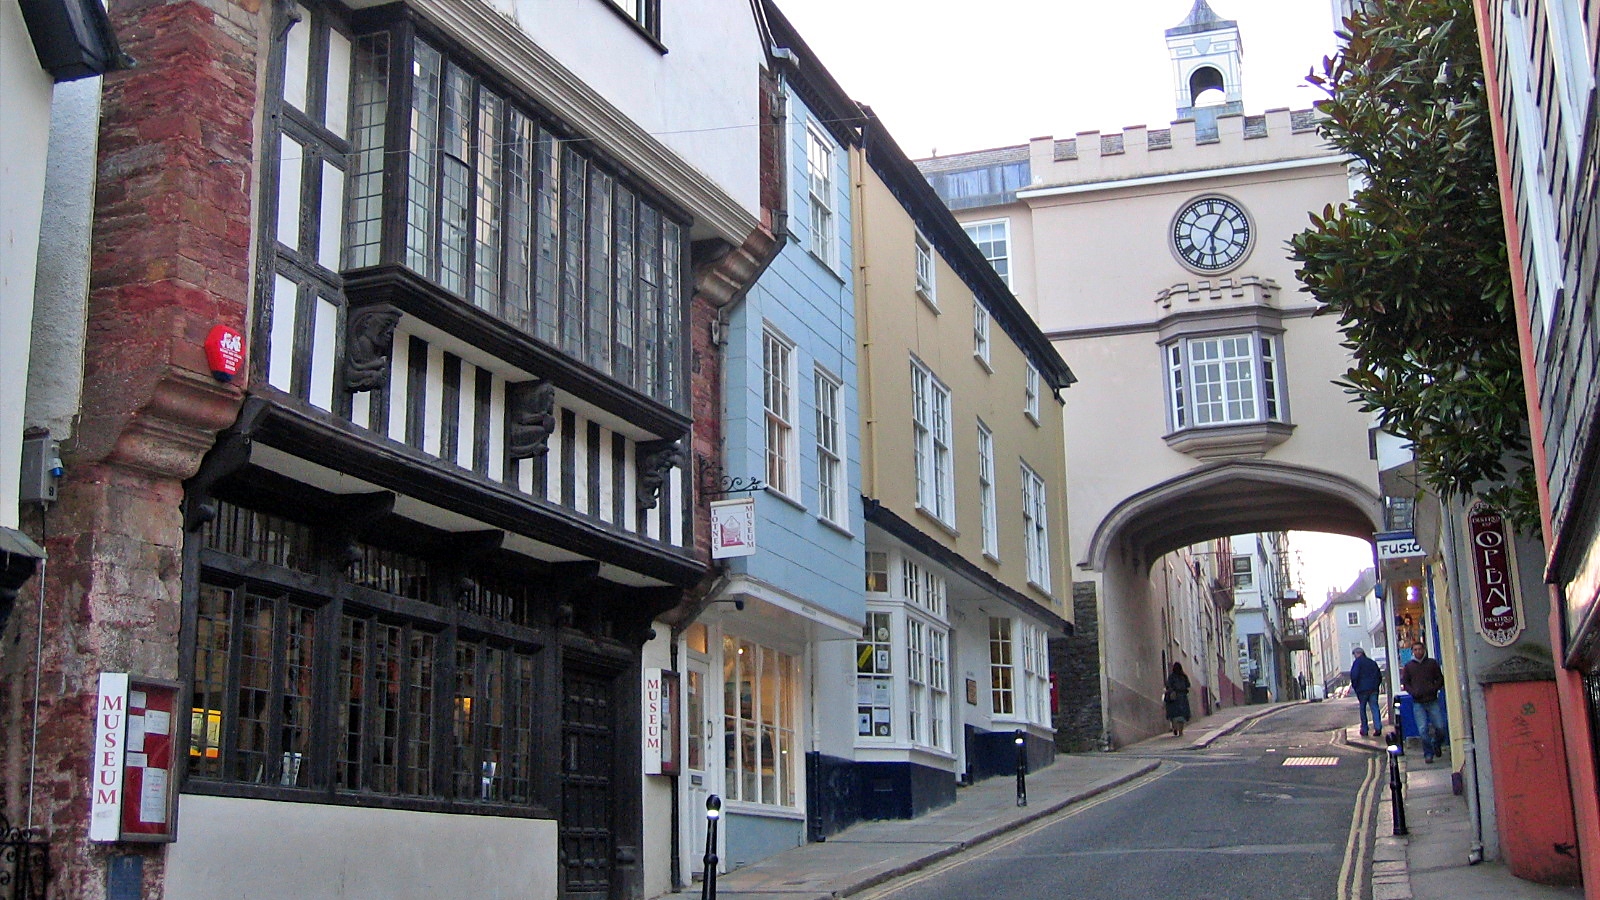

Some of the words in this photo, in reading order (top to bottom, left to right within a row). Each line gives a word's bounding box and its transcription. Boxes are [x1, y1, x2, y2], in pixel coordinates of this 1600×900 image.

[745, 505, 754, 548] MUSEUM
[1475, 530, 1509, 606] OPEN
[96, 695, 123, 804] MUSEUM
[647, 679, 659, 748] MUSEUM
